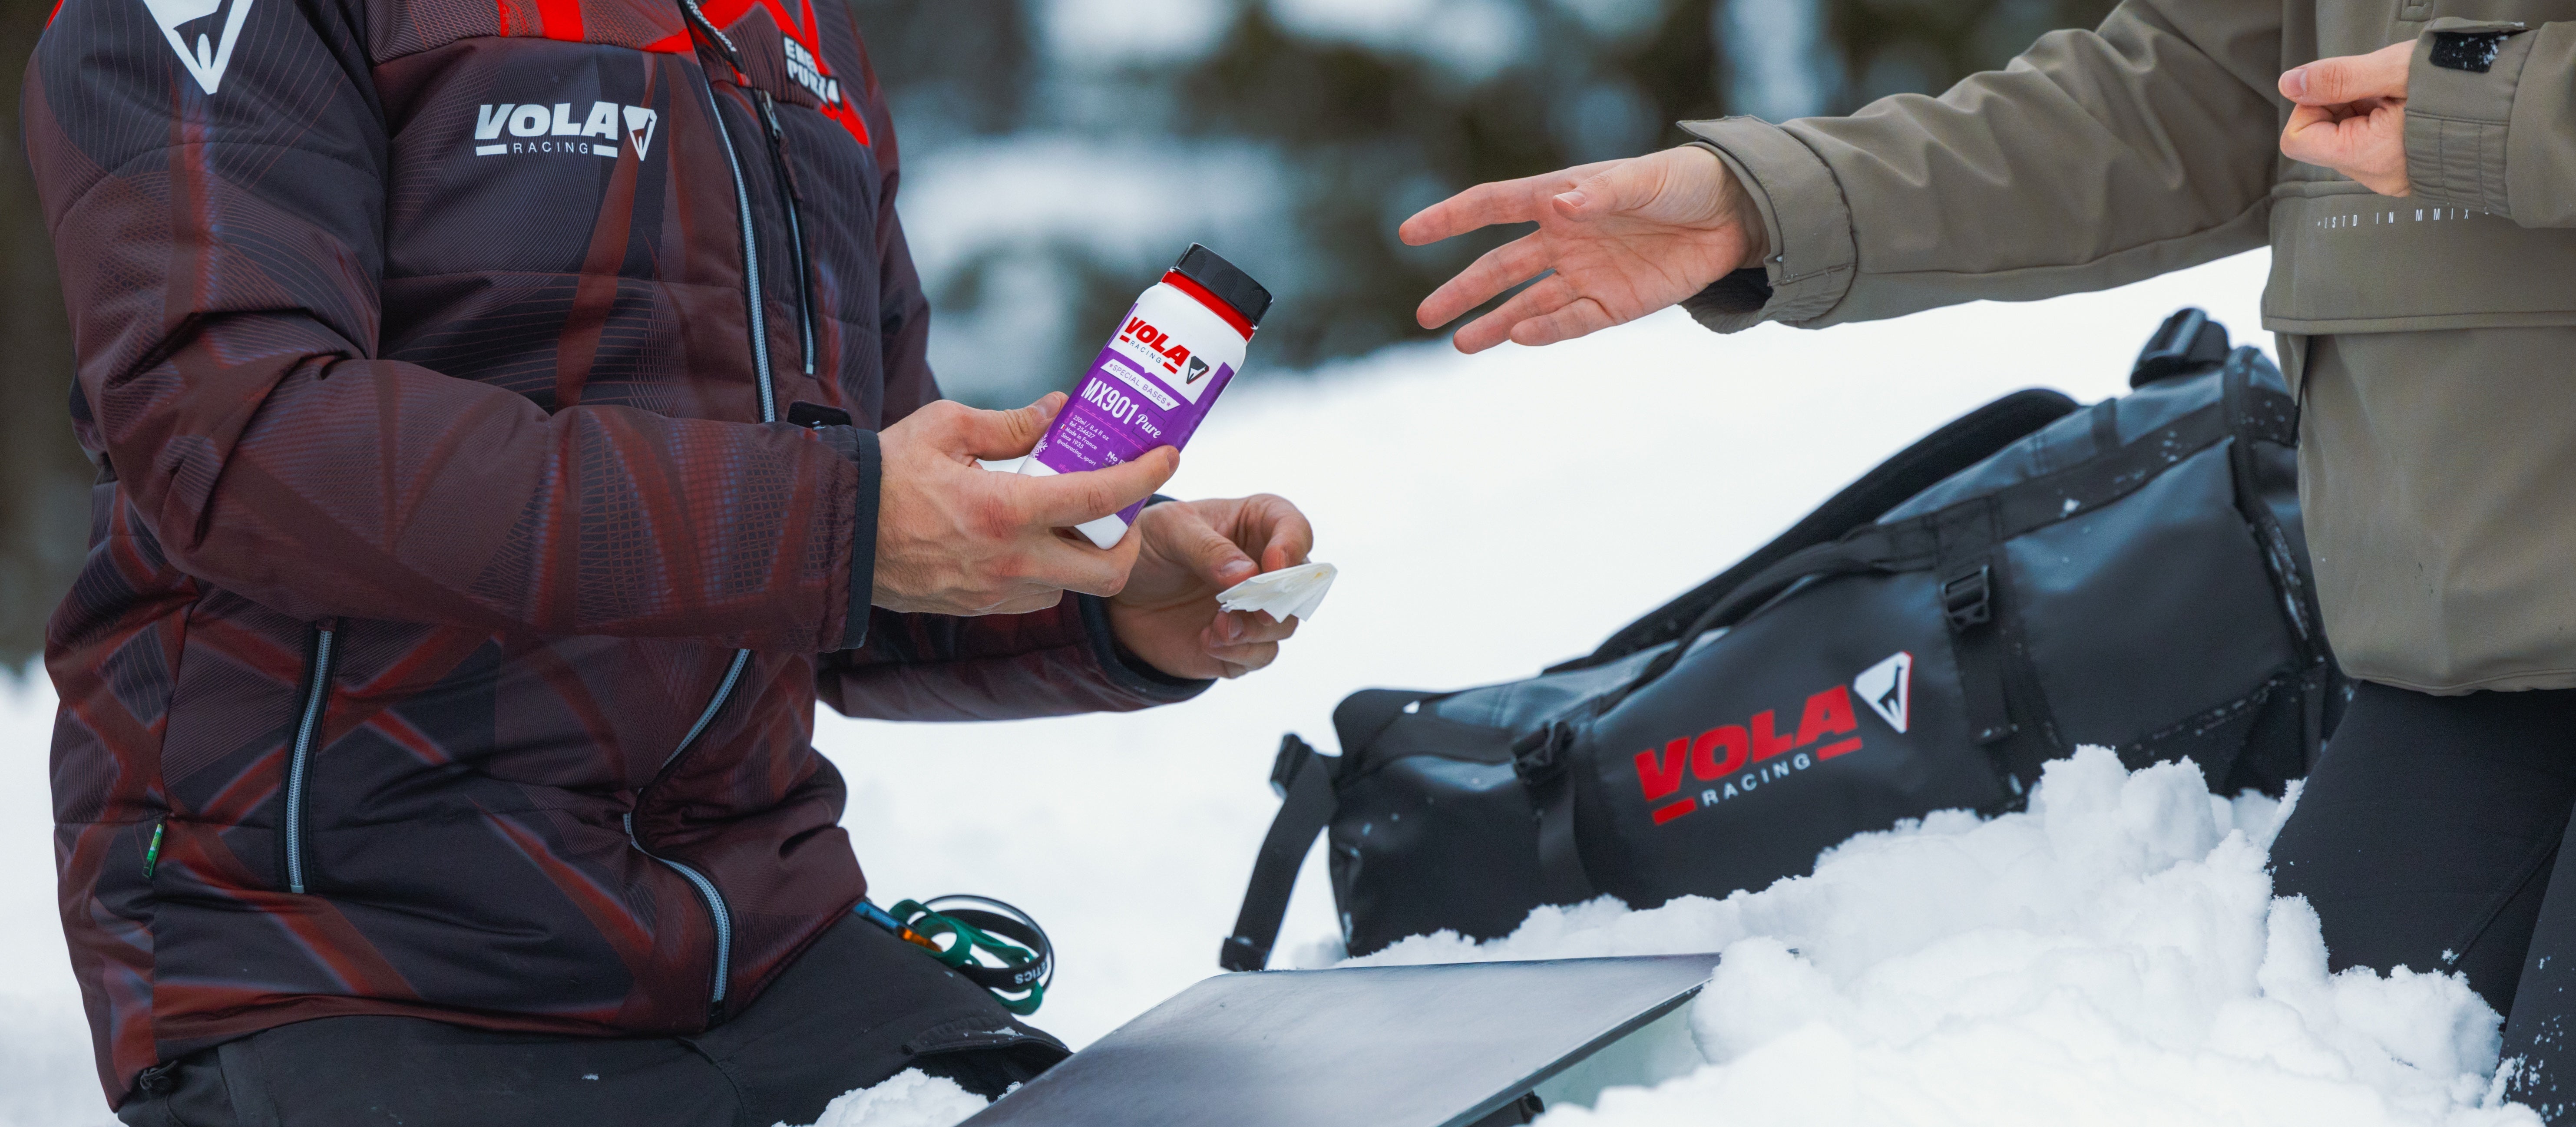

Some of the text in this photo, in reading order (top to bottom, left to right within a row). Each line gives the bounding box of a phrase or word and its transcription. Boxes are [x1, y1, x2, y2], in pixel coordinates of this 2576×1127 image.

[475, 101, 618, 140] VOLA
[514, 142, 588, 154] RACING
[2377, 212, 2394, 224] IN
[2416, 208, 2469, 221] MMIX
[1124, 317, 1190, 367] VOLA
[1130, 340, 1162, 364] RACING
[1112, 365, 1167, 404] SPECIAL BASES
[1081, 377, 1161, 439] MX901 Pure
[1073, 415, 1087, 426] 250ml
[1077, 426, 1095, 438] 254627
[1061, 433, 1084, 449] Since 1935
[1065, 427, 1077, 436] Made
[1081, 437, 1097, 450] France
[1057, 439, 1096, 466] @volaracing_sport
[1107, 451, 1118, 462] No
[1634, 684, 1858, 802] VOLA
[1701, 753, 1811, 807] RACING
